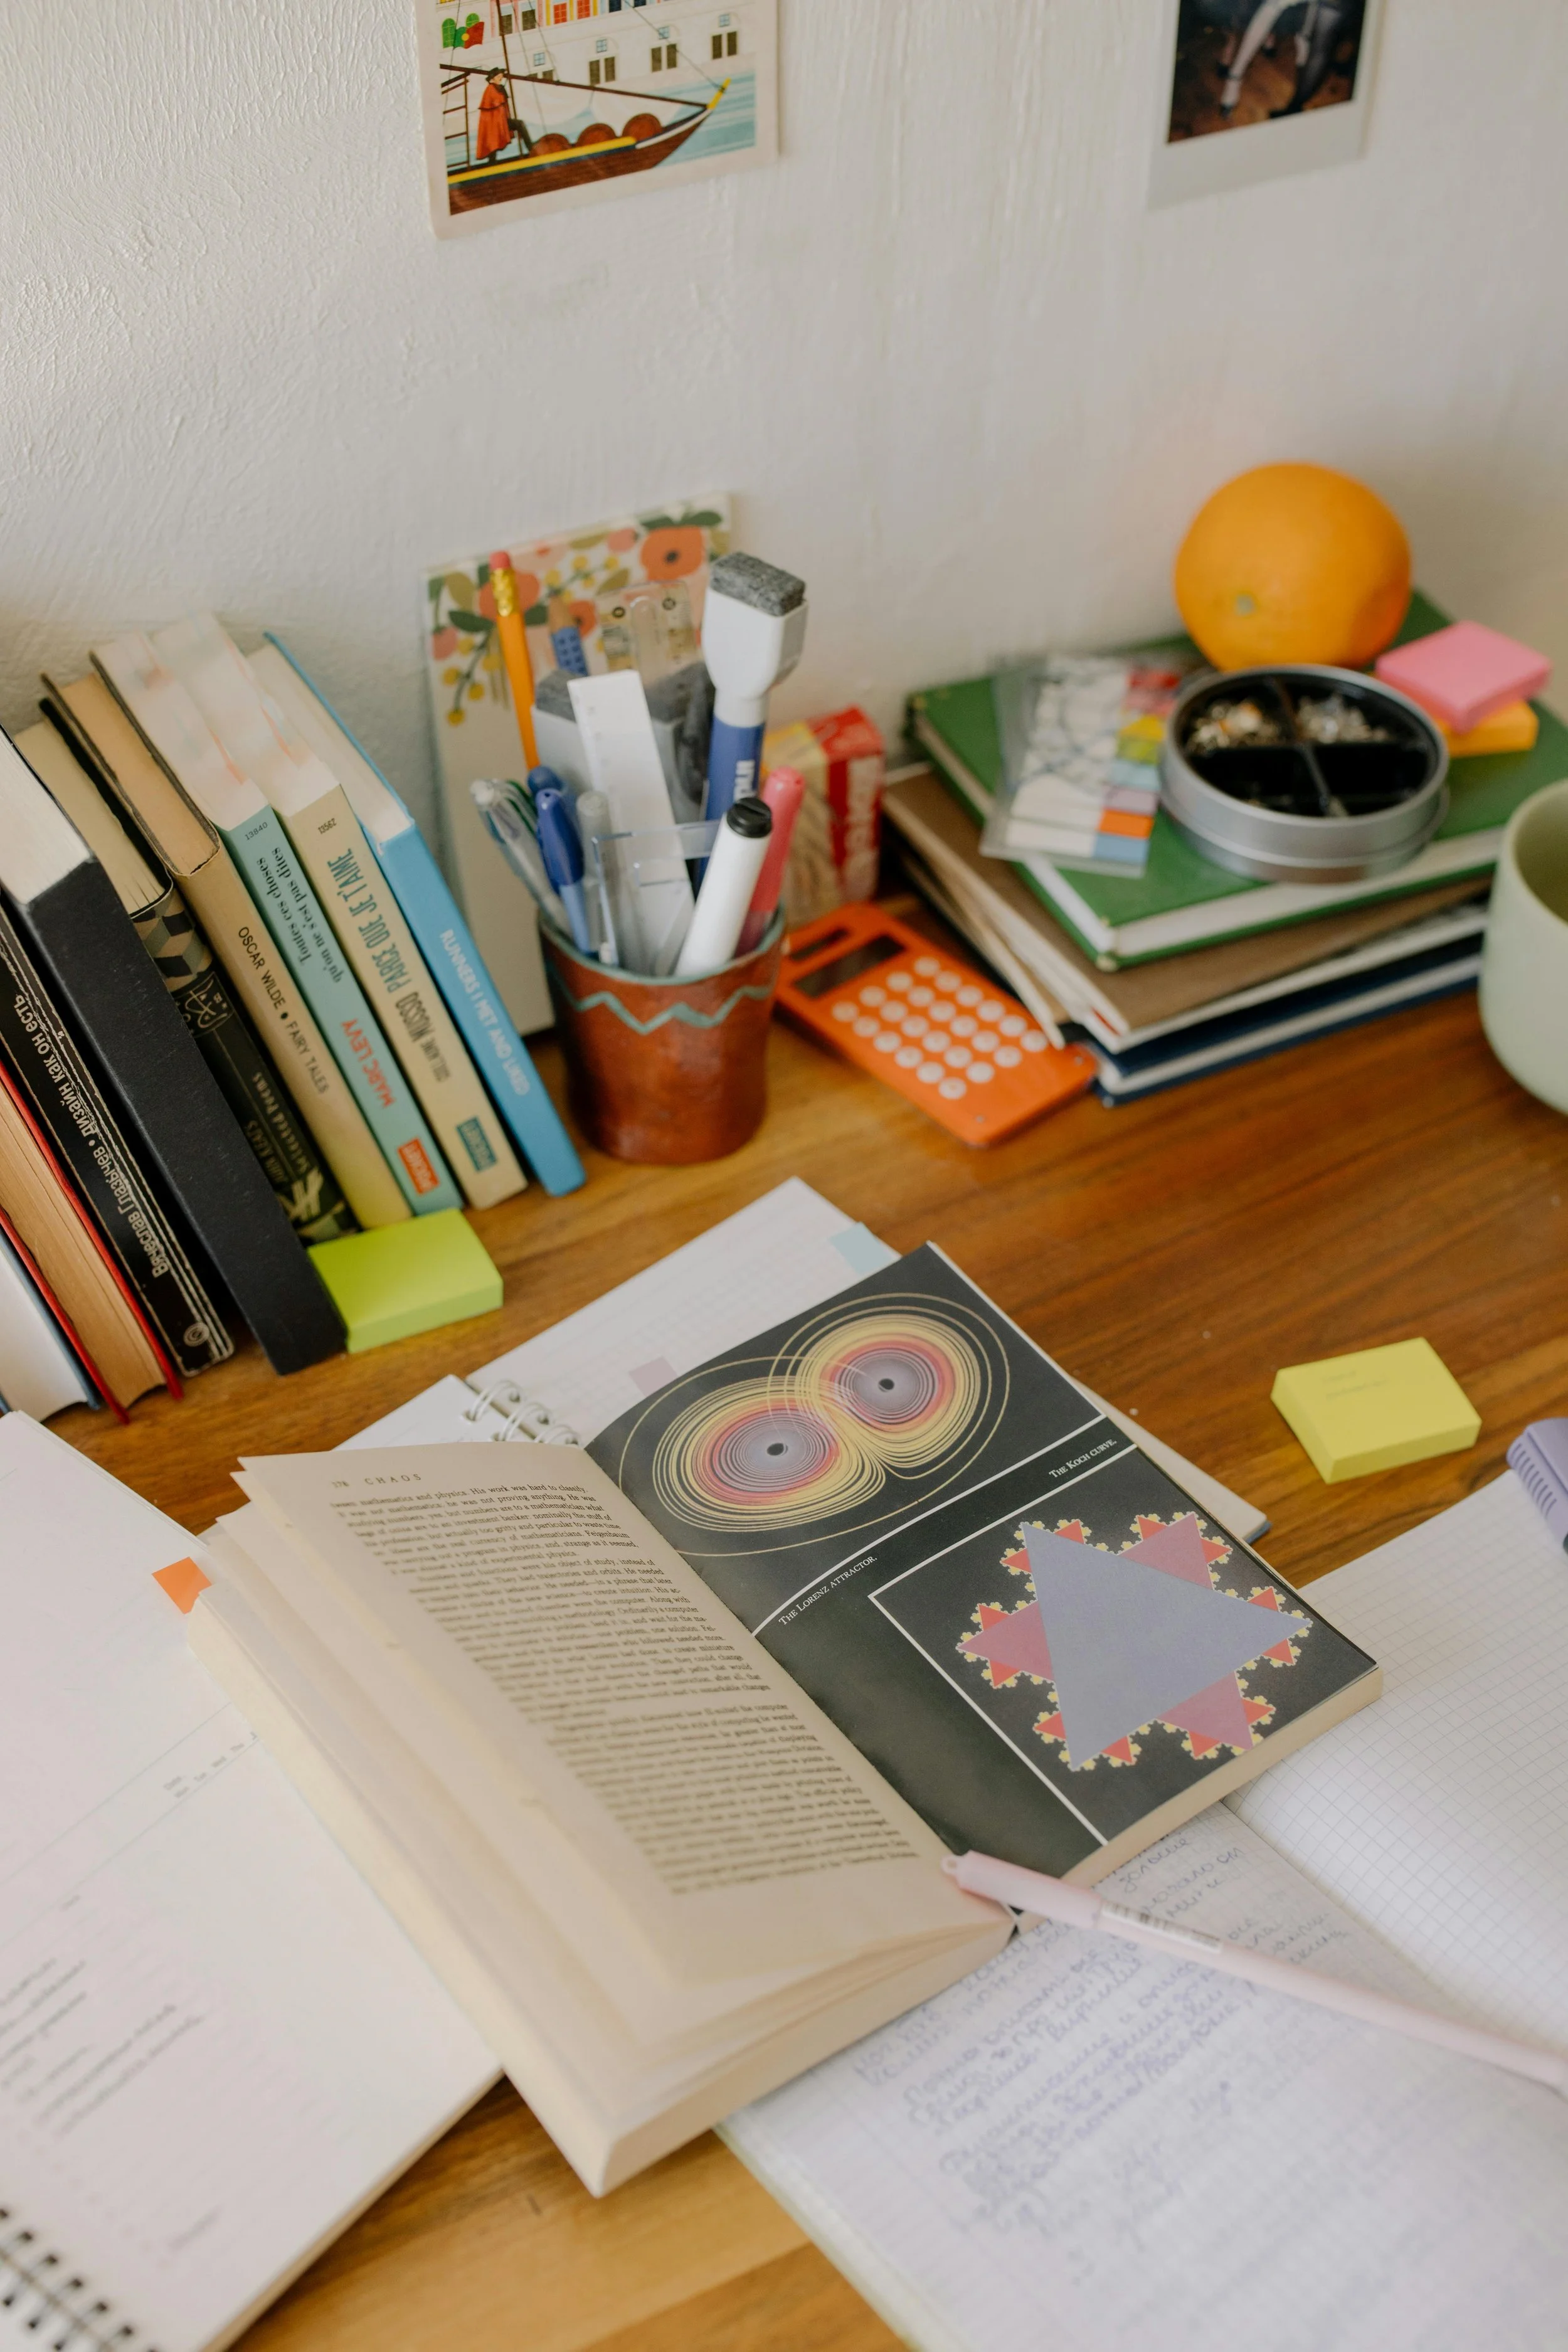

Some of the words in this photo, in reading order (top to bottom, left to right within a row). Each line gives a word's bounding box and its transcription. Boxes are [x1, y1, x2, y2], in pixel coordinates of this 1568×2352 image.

[245, 822, 268, 840] 13840
[318, 818, 337, 835] 13562
[272, 847, 292, 879] dites
[327, 847, 368, 903] T'AIME
[257, 857, 282, 899] choses
[287, 879, 307, 904] pas
[277, 901, 292, 921] ces
[298, 903, 317, 931] s'est
[349, 894, 377, 917] JE
[289, 923, 312, 965] Toutes
[313, 931, 326, 948] ne
[358, 913, 391, 949] QUE
[321, 948, 345, 983] qu'on
[372, 943, 413, 994] PARCE
[440, 929, 480, 994] RUNNERS
[238, 926, 265, 970] OSCAR
[261, 970, 286, 1010] WILDE
[287, 1020, 310, 1055] FAIRY
[305, 1056, 329, 1094] TALES
[471, 991, 484, 1001] I
[14, 993, 39, 1033] есть
[395, 991, 436, 1043] MUSSO
[475, 999, 499, 1027] MET
[31, 1034, 50, 1055] он
[341, 1019, 373, 1062] LEVY
[489, 1028, 512, 1059] AND
[43, 1049, 65, 1081] как
[502, 1057, 530, 1096] LIKED
[362, 1059, 395, 1108] MARC
[58, 1080, 98, 1139] дизайн
[127, 1207, 169, 1279] Вячеслав
[435, 1491, 470, 1500] physics.
[558, 1484, 588, 1493] classify.
[497, 1495, 530, 1503] proving
[531, 1493, 566, 1501] anything.
[462, 1507, 499, 1515] numbers
[495, 1525, 517, 1534] gritty
[534, 1521, 573, 1530] particular
[521, 1530, 585, 1540] mathematicians.
[585, 1530, 630, 1539] Feigenbaum
[563, 1540, 591, 1548] strange
[608, 1540, 639, 1549] seemed,
[594, 1558, 619, 1566] study,
[613, 1577, 639, 1586] phrase
[649, 1596, 674, 1604] Along
